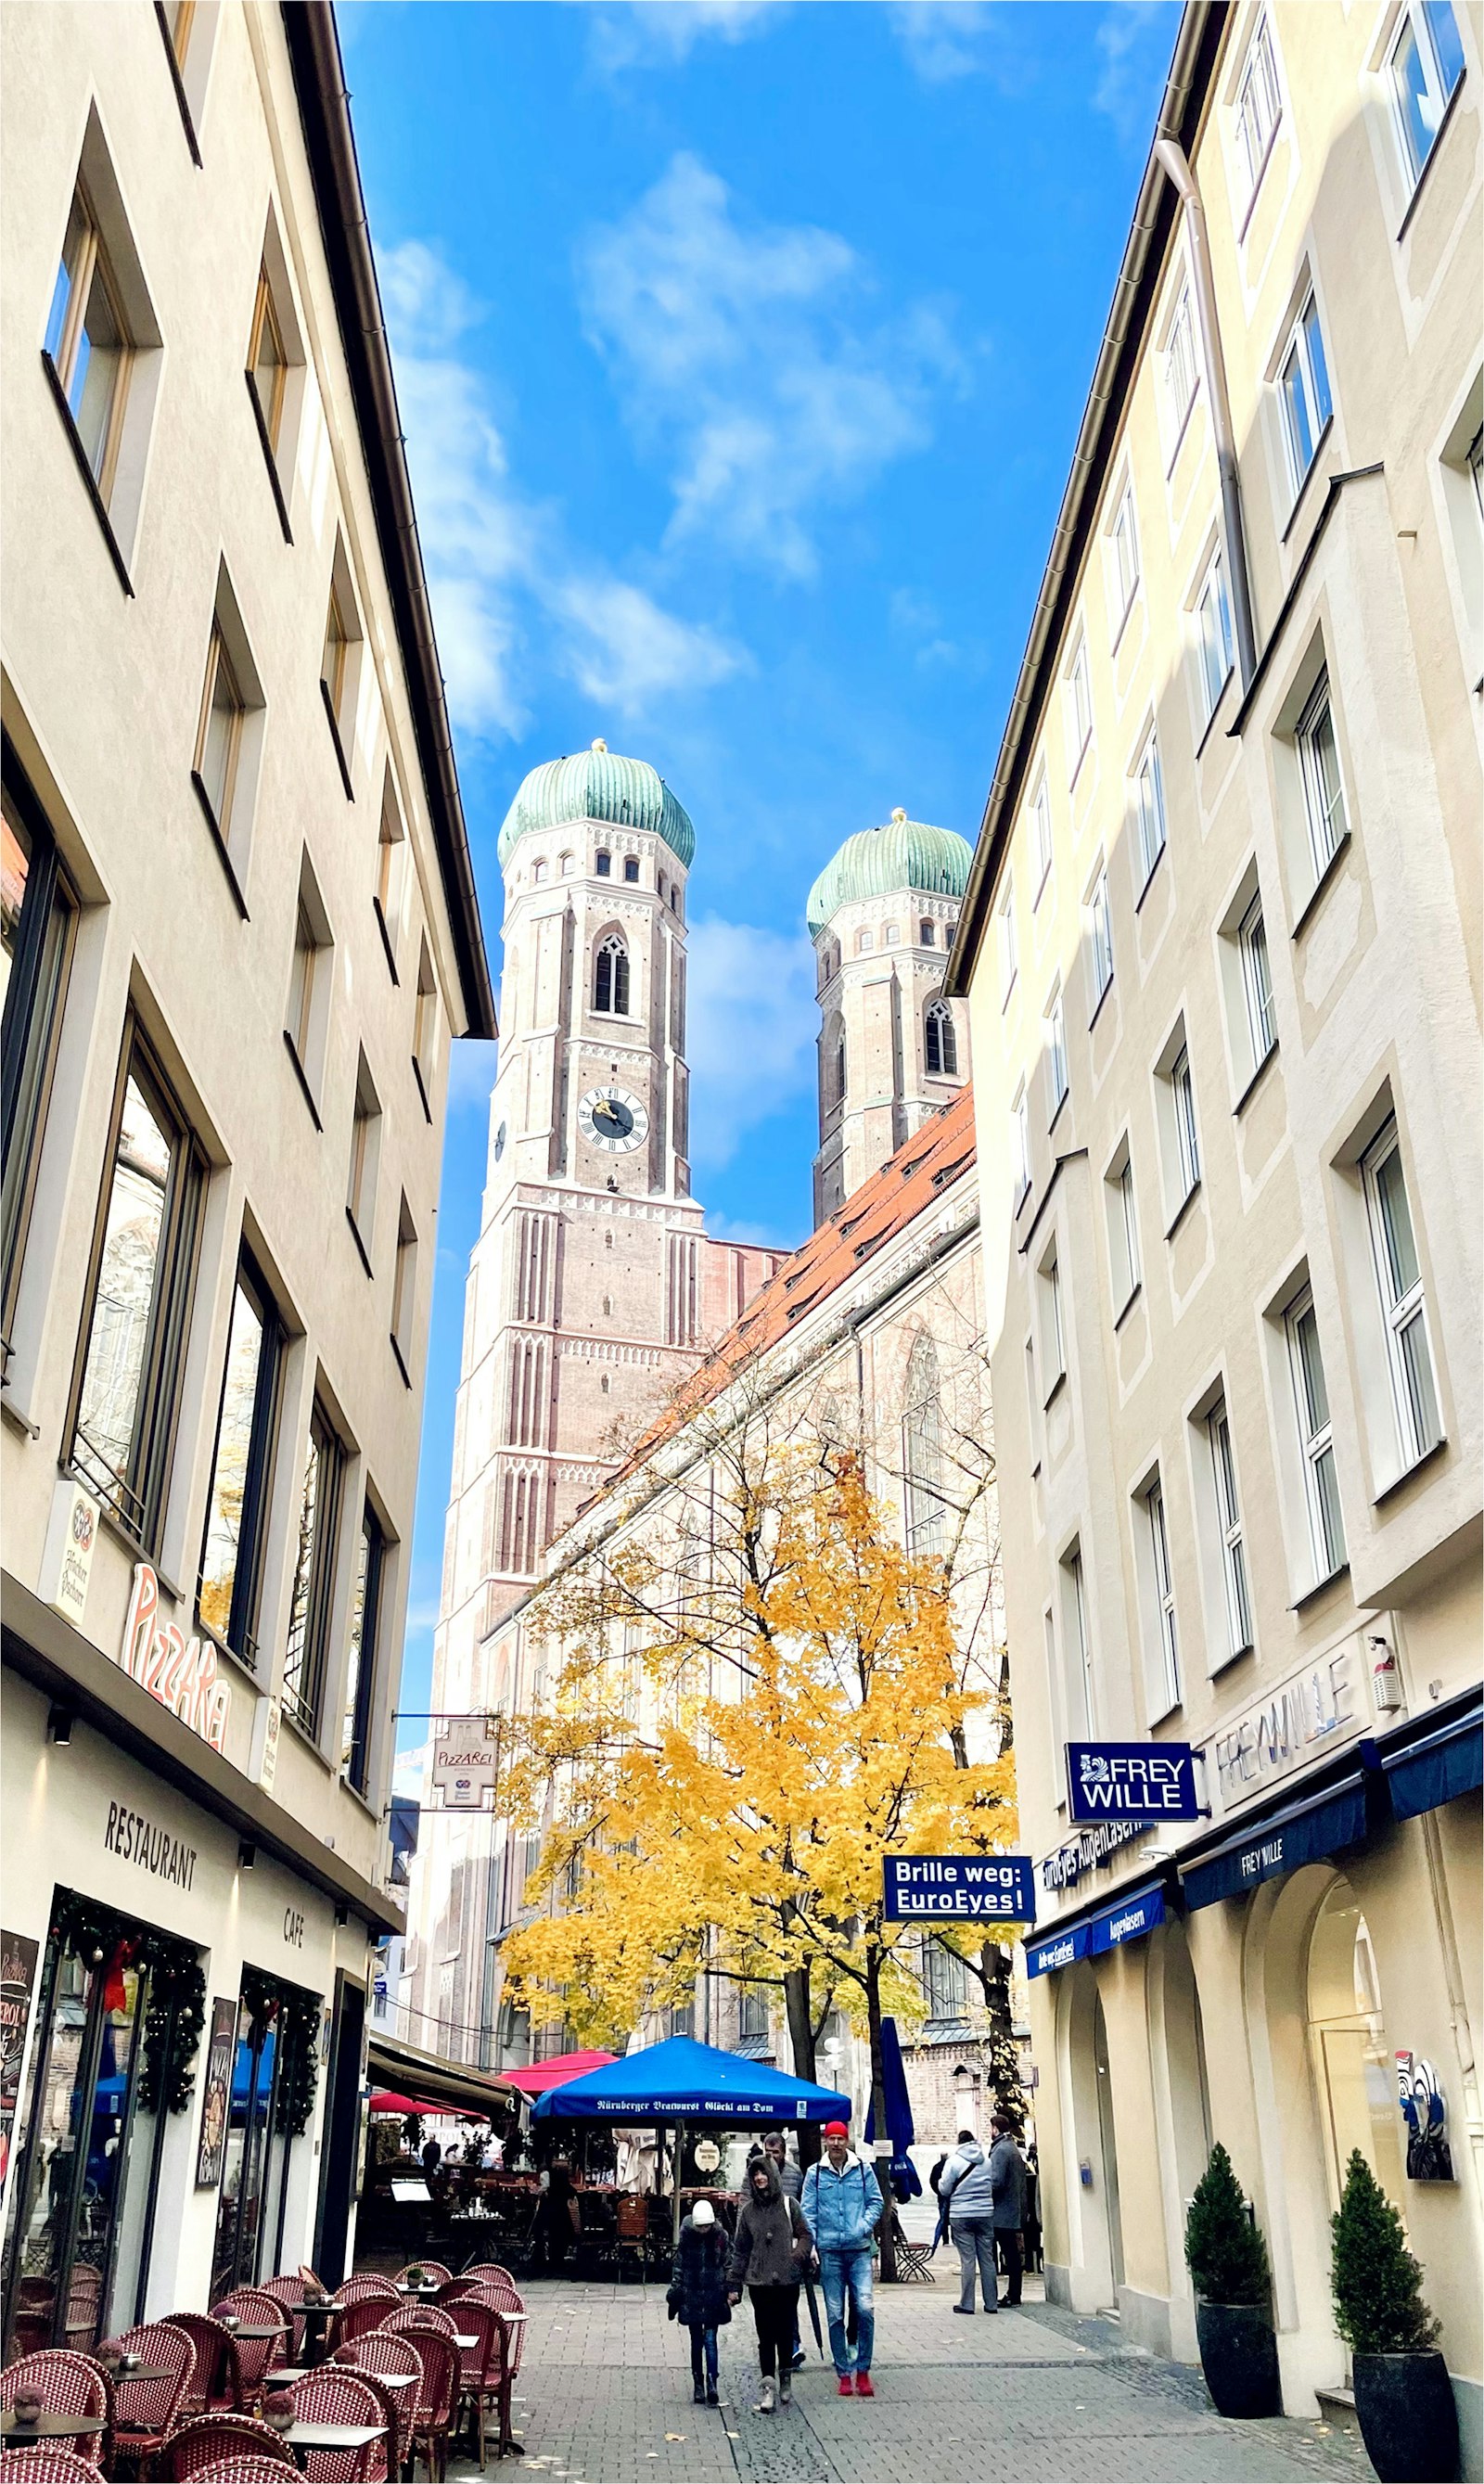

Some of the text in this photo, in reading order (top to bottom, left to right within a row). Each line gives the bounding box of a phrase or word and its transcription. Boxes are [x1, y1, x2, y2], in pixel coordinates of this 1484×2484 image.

[438, 1751, 493, 1766] PIZZAREI
[1109, 1759, 1185, 1783] FREY
[1081, 1784, 1183, 1809] WILLE
[104, 1800, 198, 1892] RESTAURANT
[1241, 1837, 1284, 1877] FREY WILLE
[895, 1862, 1021, 1888] Brille weg:
[897, 1889, 1024, 1914] EuroEyes!
[596, 2100, 650, 2113] Nürnberger
[653, 2101, 699, 2111] Bratwurst
[736, 2104, 750, 2112] am
[752, 2103, 774, 2113] Dom
